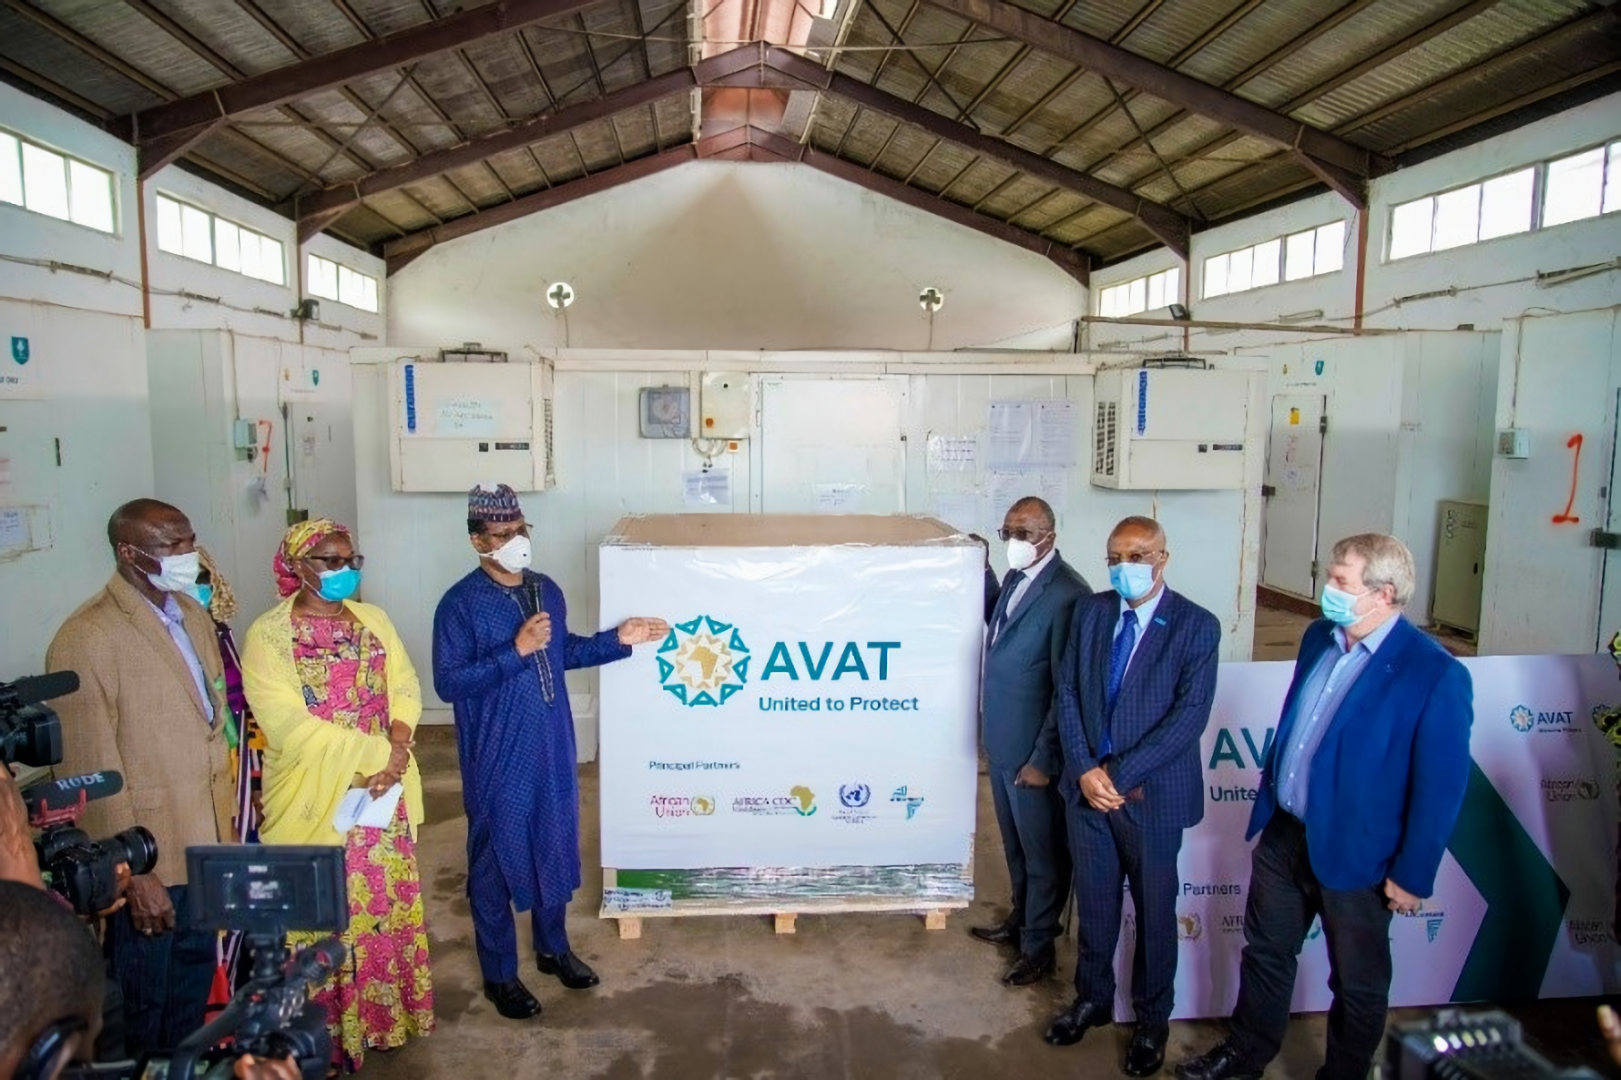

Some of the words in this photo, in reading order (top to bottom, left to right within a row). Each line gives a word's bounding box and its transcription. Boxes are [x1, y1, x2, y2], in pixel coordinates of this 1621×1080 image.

[1551, 433, 1583, 524] 1
[760, 641, 901, 681] AVAT
[758, 696, 821, 712] United
[825, 697, 845, 712] to
[849, 696, 920, 712] Protect
[1537, 711, 1574, 726] AVAT
[1208, 727, 1276, 770] AV
[1209, 785, 1259, 803] Unite
[1183, 882, 1242, 897] Partners
